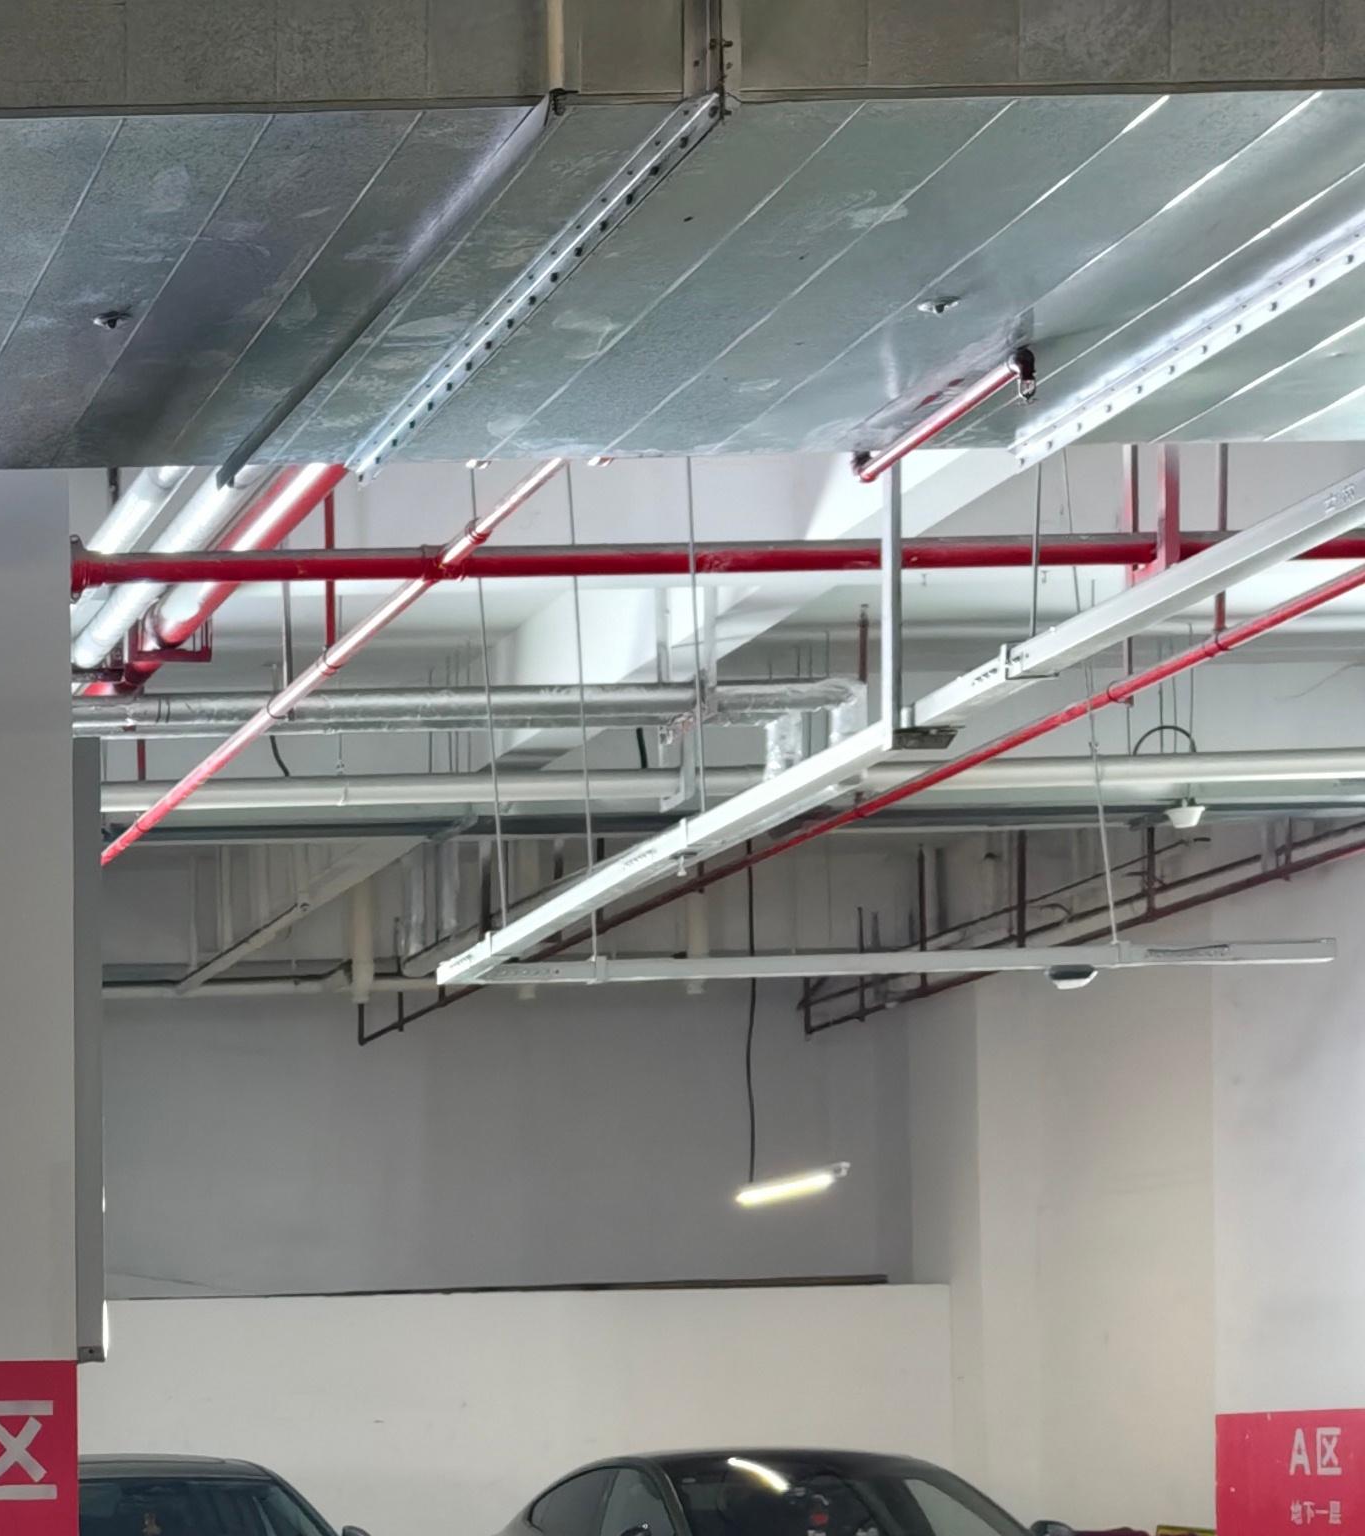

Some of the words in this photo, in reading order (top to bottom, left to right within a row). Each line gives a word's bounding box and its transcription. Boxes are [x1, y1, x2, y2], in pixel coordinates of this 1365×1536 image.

[1289, 1427, 1343, 1476] A区
[1290, 1500, 1342, 1525] 地下一层
